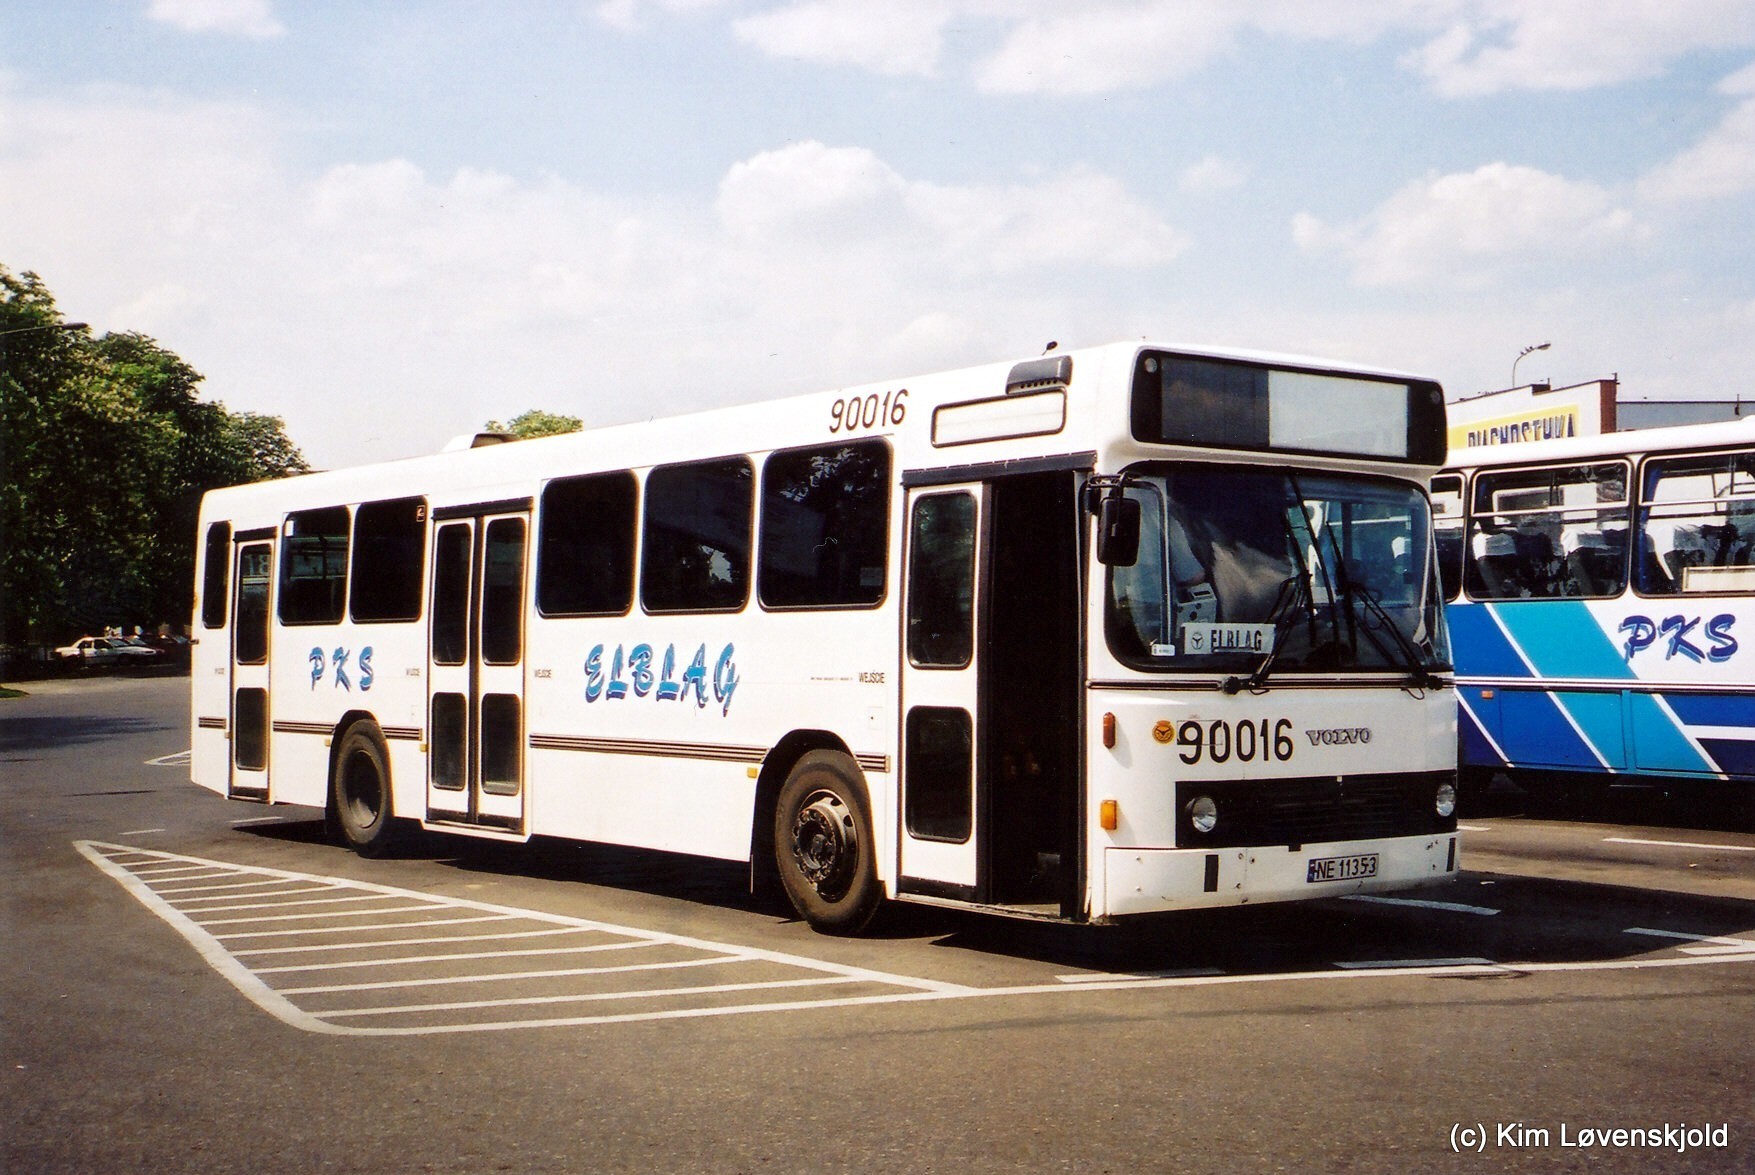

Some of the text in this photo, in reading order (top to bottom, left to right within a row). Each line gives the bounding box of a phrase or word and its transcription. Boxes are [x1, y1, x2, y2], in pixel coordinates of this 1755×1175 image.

[829, 388, 909, 433] 90016
[1618, 613, 1739, 664] PKS
[309, 645, 374, 692] PKS
[1177, 718, 1293, 765] 90016
[1305, 727, 1373, 746] VOLVO
[1316, 856, 1377, 880] NE 11353
